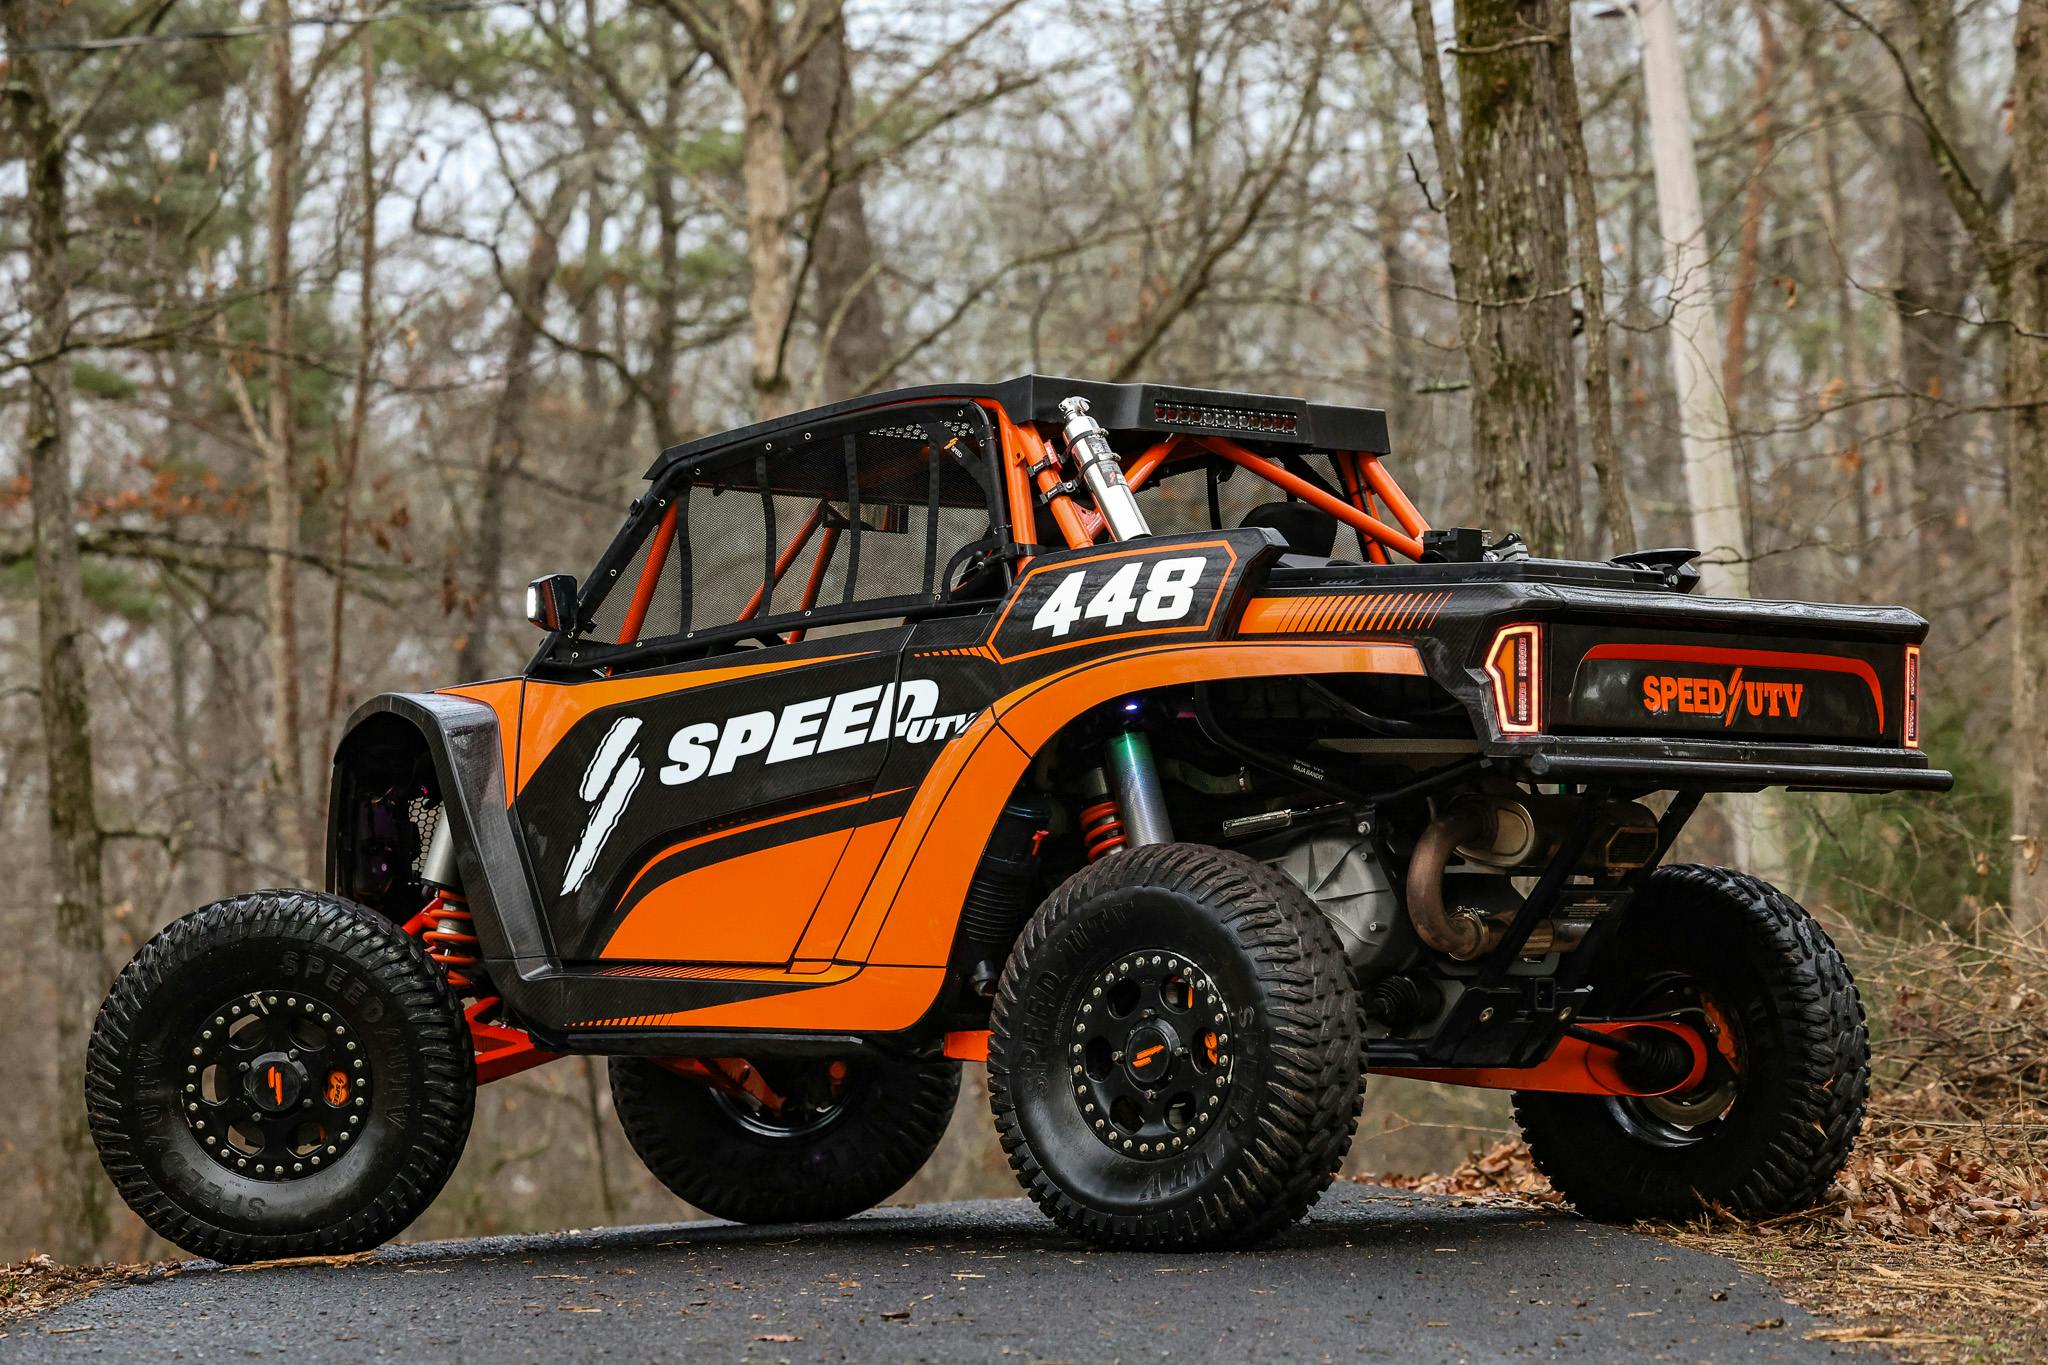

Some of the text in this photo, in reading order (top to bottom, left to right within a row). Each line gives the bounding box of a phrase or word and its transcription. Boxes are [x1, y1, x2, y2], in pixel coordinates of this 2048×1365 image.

[1032, 556, 1208, 638] 448
[659, 679, 940, 786] SPEED
[1642, 674, 1804, 718] SPEED UTV
[279, 949, 386, 1024] SPEED
